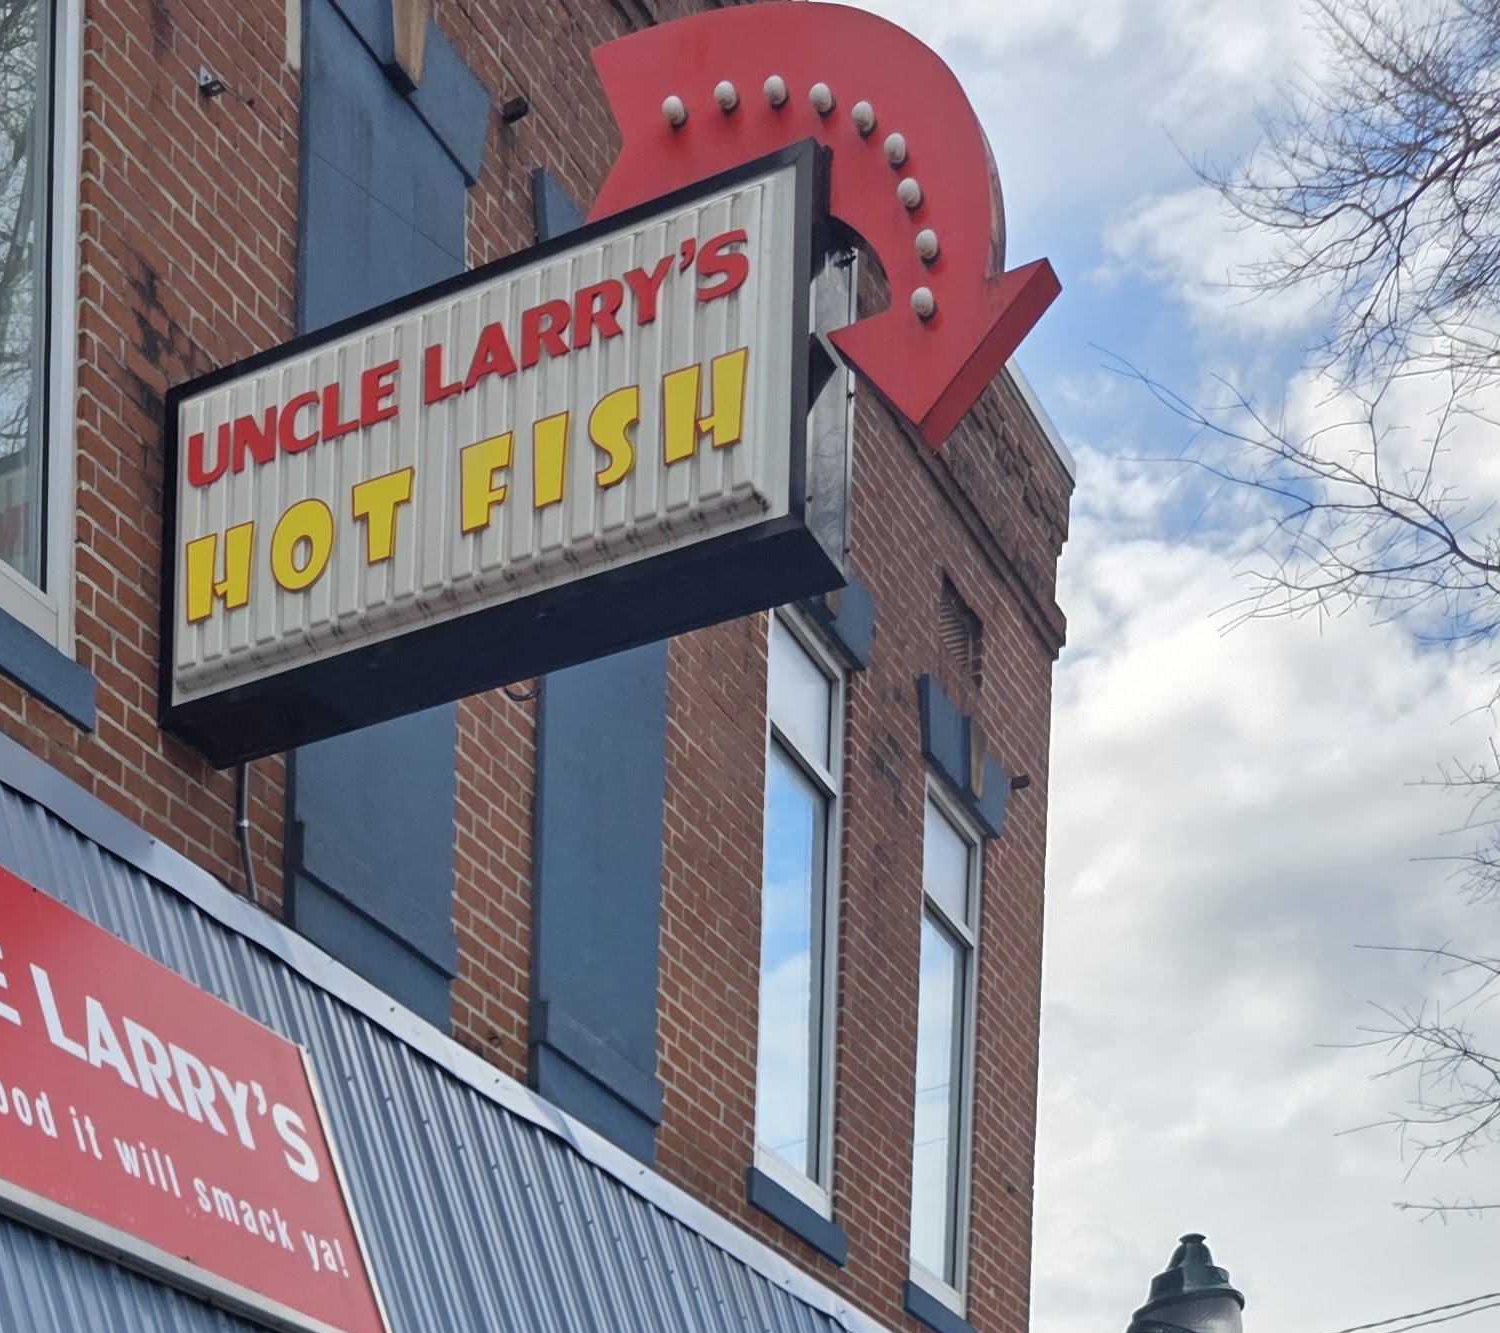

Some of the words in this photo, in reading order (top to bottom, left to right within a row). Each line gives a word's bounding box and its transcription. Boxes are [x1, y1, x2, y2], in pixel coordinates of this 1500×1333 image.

[187, 359, 402, 488] UNCLE
[423, 228, 750, 405] LARRY'S
[185, 465, 415, 624] HOT
[459, 346, 749, 535] FISH
[29, 961, 319, 1183] LARRY'S
[69, 1106, 103, 1160] it
[113, 1134, 182, 1198] will
[192, 1174, 295, 1252] smack
[302, 1231, 349, 1278] ya!
